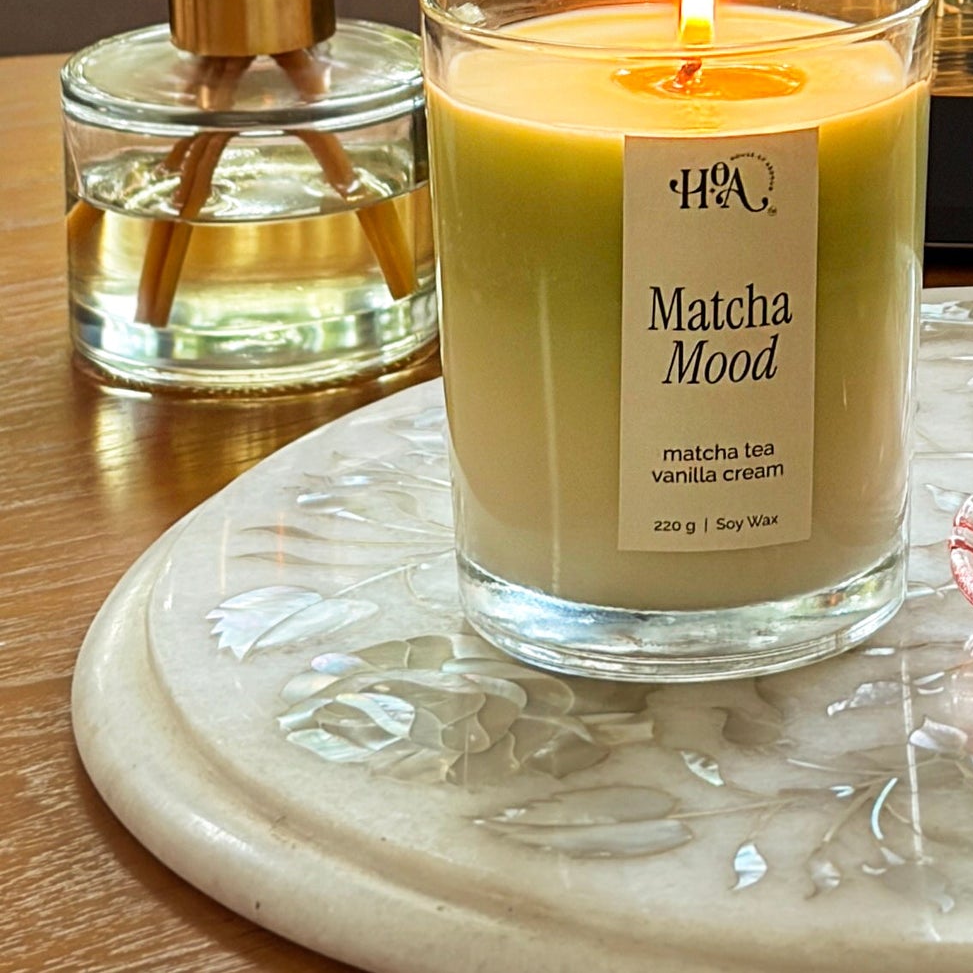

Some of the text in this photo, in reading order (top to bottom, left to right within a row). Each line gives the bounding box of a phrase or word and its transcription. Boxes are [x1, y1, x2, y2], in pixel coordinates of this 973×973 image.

[648, 283, 792, 331] Matcha
[662, 333, 779, 384] Mood
[664, 443, 774, 461] matcha tea
[652, 464, 783, 483] vanilla cream
[653, 520, 682, 532] 220
[685, 521, 696, 535] g
[717, 518, 743, 532] Soy
[747, 515, 778, 527] Wax
